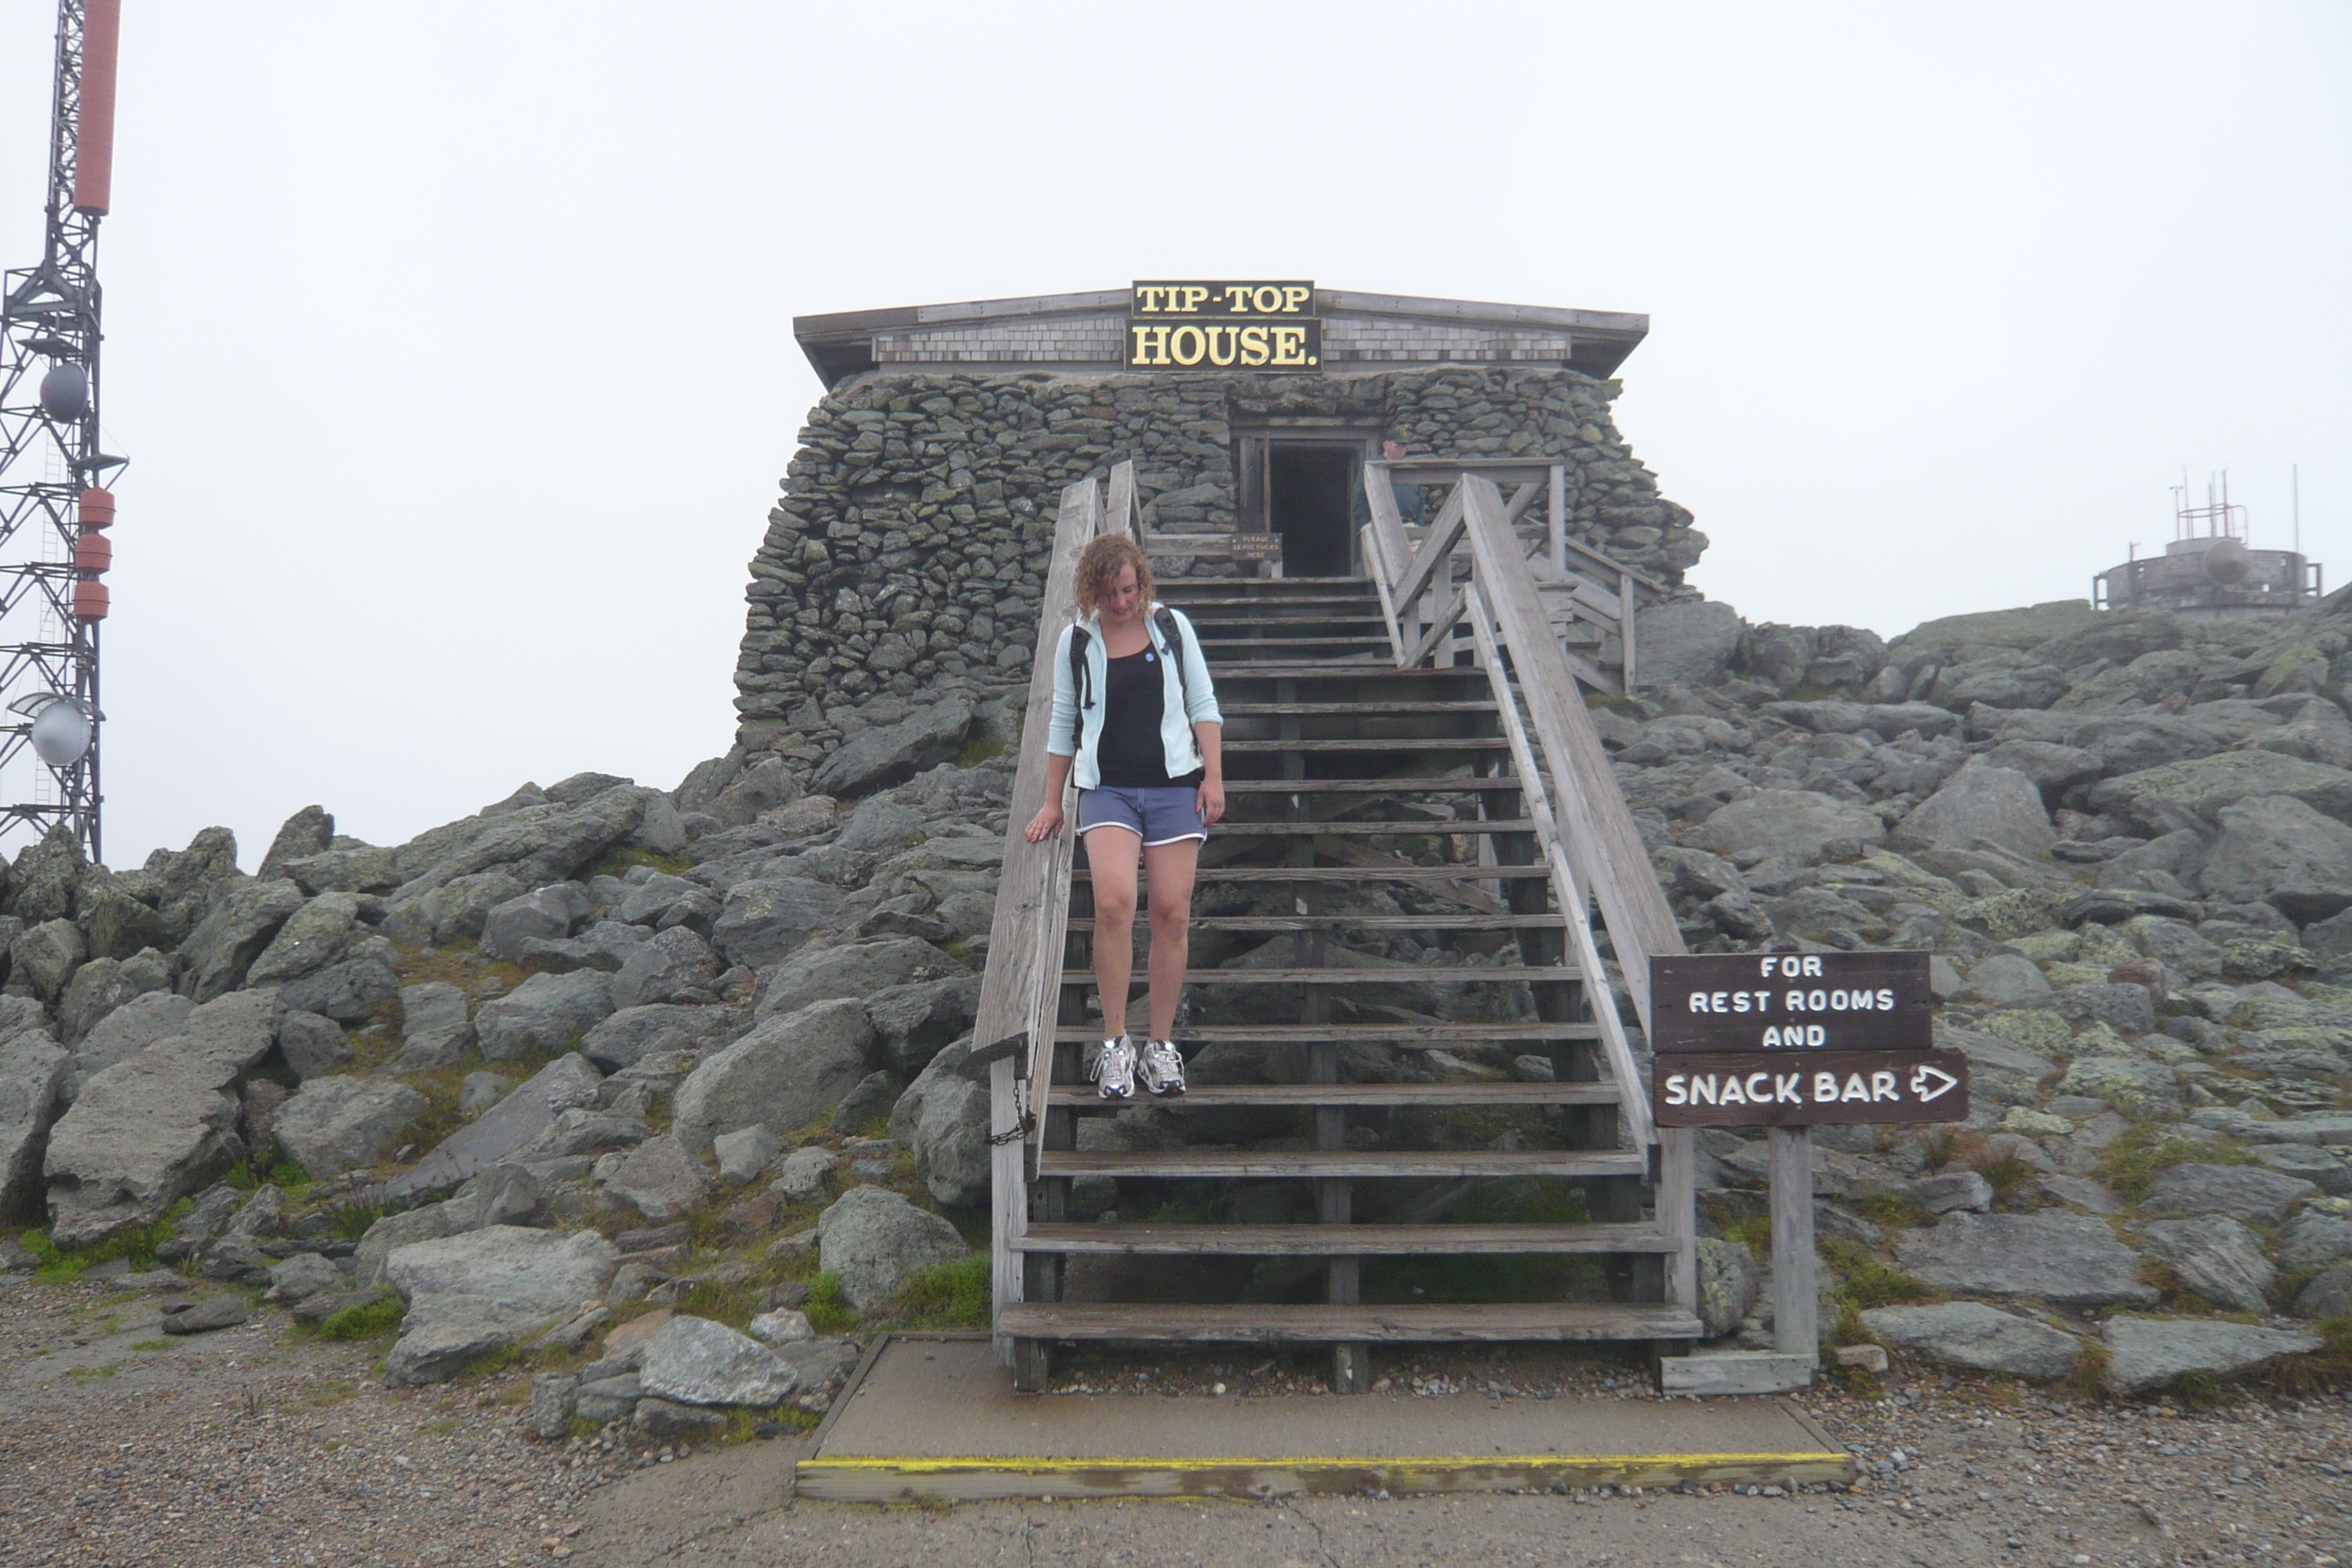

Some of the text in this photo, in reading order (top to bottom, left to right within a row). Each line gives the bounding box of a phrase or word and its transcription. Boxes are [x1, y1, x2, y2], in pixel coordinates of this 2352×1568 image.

[1136, 286, 1310, 313] TIP-TOP
[1132, 326, 1318, 366] HOUSE.
[1761, 956, 1823, 978] FOR
[1689, 988, 1895, 1013] REST ROOMS
[1762, 1025, 1826, 1047] AND
[1664, 1072, 1900, 1106] SNACK BAR
